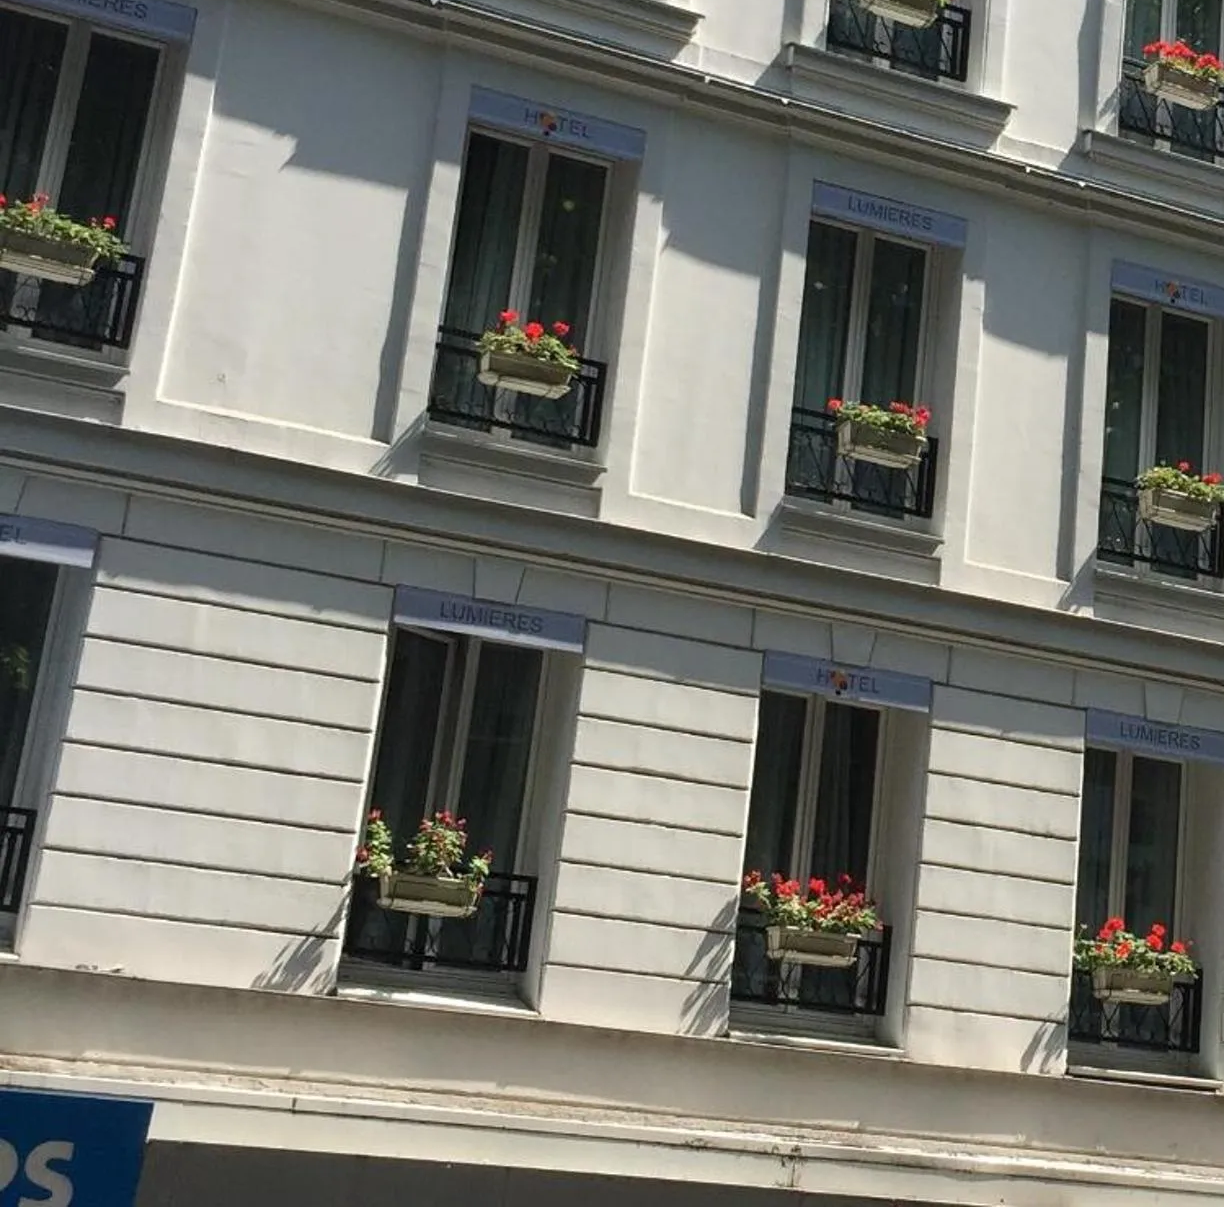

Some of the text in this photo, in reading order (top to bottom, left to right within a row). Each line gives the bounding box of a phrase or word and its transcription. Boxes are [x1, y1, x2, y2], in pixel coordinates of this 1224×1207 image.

[523, 107, 592, 139] HOTEL
[847, 195, 933, 231] LUMIERES
[440, 601, 544, 633] LUMIERES
[815, 668, 881, 696] HOTEL
[1120, 721, 1200, 750] LUMIERES
